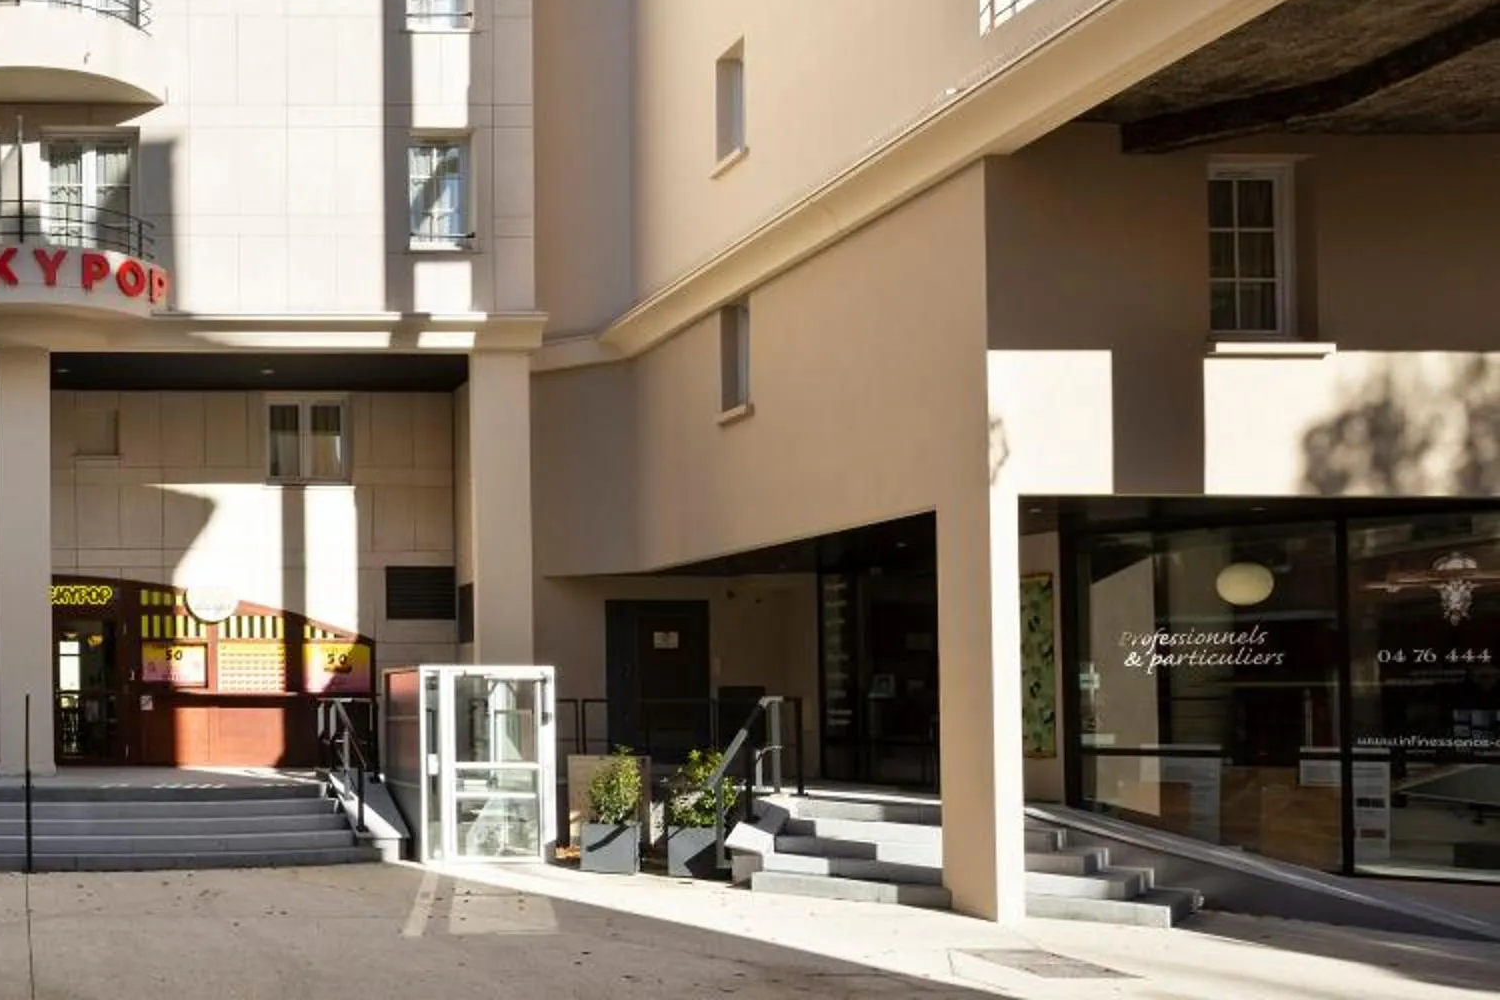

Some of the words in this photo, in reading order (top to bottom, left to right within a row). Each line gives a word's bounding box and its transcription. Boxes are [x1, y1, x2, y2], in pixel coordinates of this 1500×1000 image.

[1118, 625, 1269, 656] Professionnels
[1124, 651, 1144, 667] &
[1147, 647, 1286, 675] particuliers
[1377, 648, 1407, 662] 04
[1412, 648, 1437, 663] 76
[1445, 648, 1493, 663] 444
